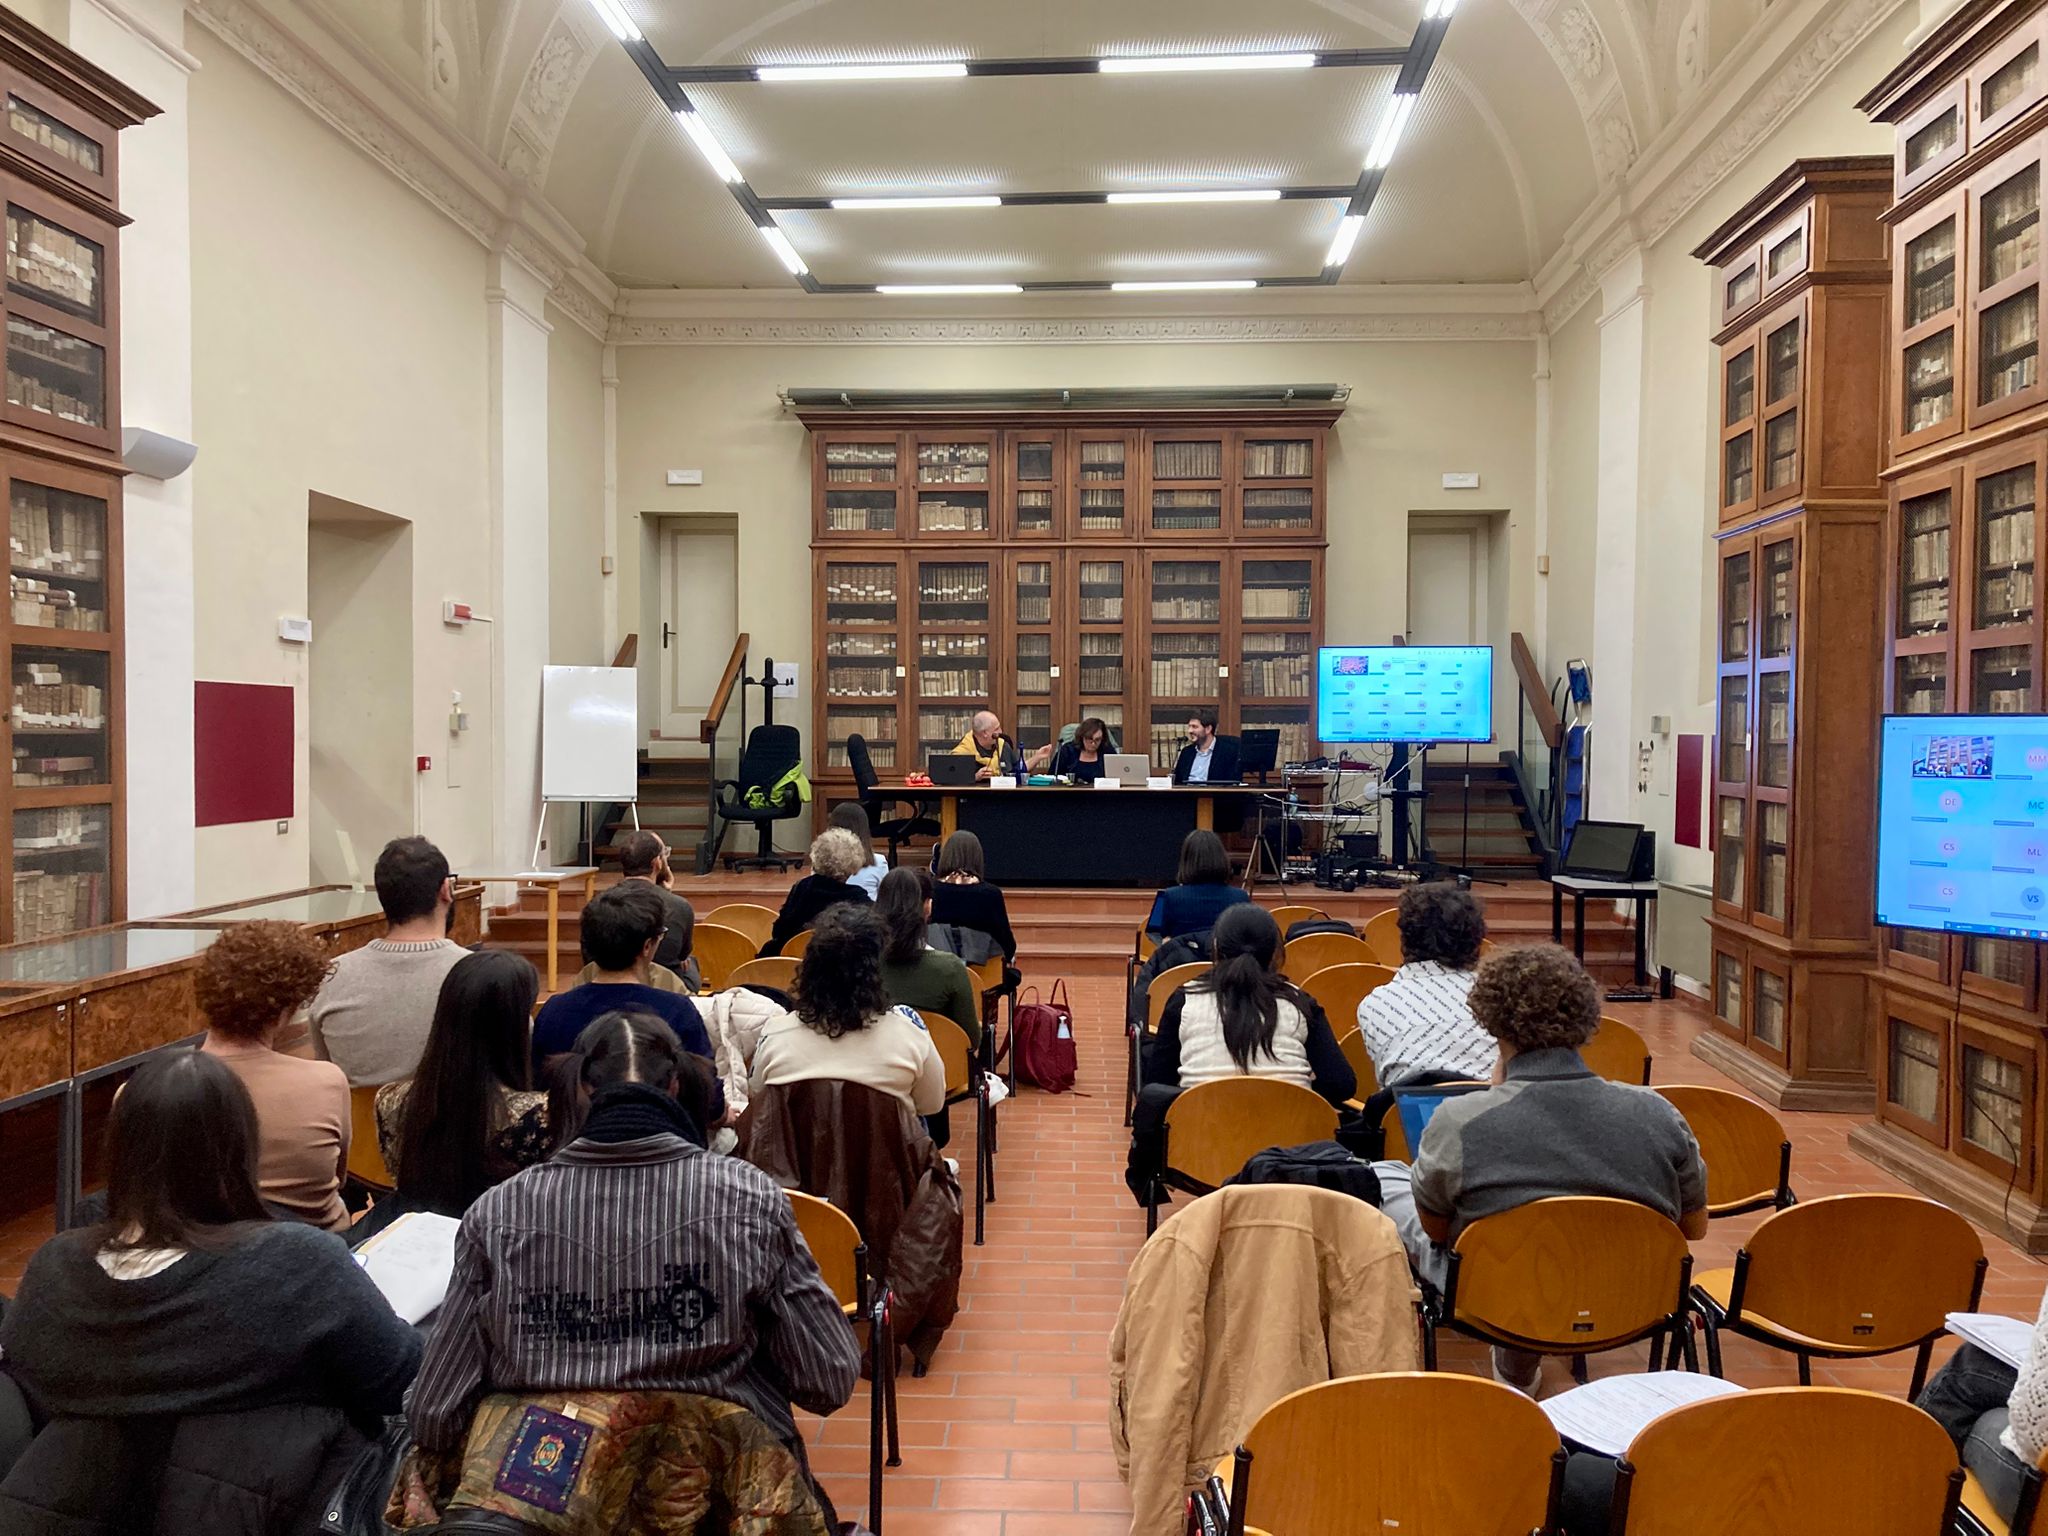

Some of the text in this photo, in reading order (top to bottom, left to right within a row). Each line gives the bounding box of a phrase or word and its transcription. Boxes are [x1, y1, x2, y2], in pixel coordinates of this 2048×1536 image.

[2028, 801, 2045, 810] MC
[1943, 843, 1955, 851] CS
[2027, 848, 2042, 857] ML
[1942, 888, 1954, 896] CS
[2026, 894, 2040, 903] VS
